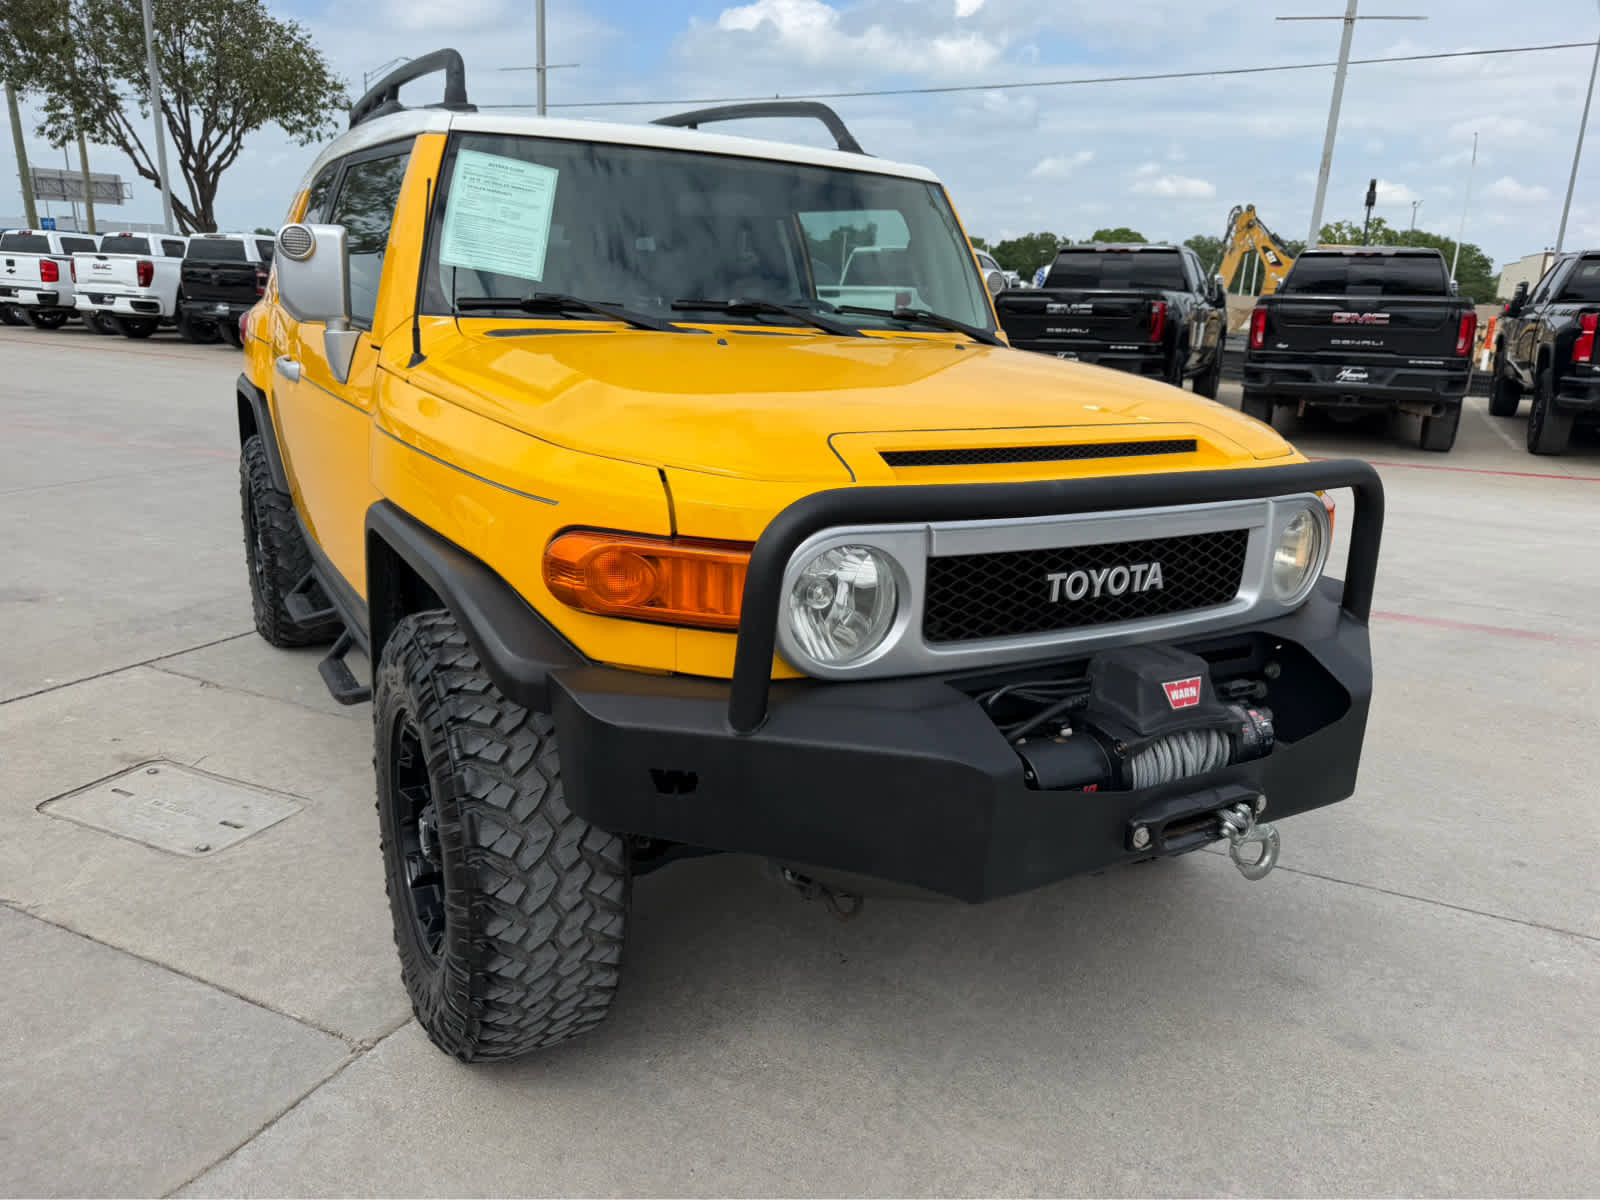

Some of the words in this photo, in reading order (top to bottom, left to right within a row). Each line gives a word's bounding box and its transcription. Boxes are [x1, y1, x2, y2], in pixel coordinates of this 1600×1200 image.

[1332, 312, 1390, 324] GMC
[1047, 561, 1165, 603] TOYOTA
[1170, 687, 1197, 700] WARN
